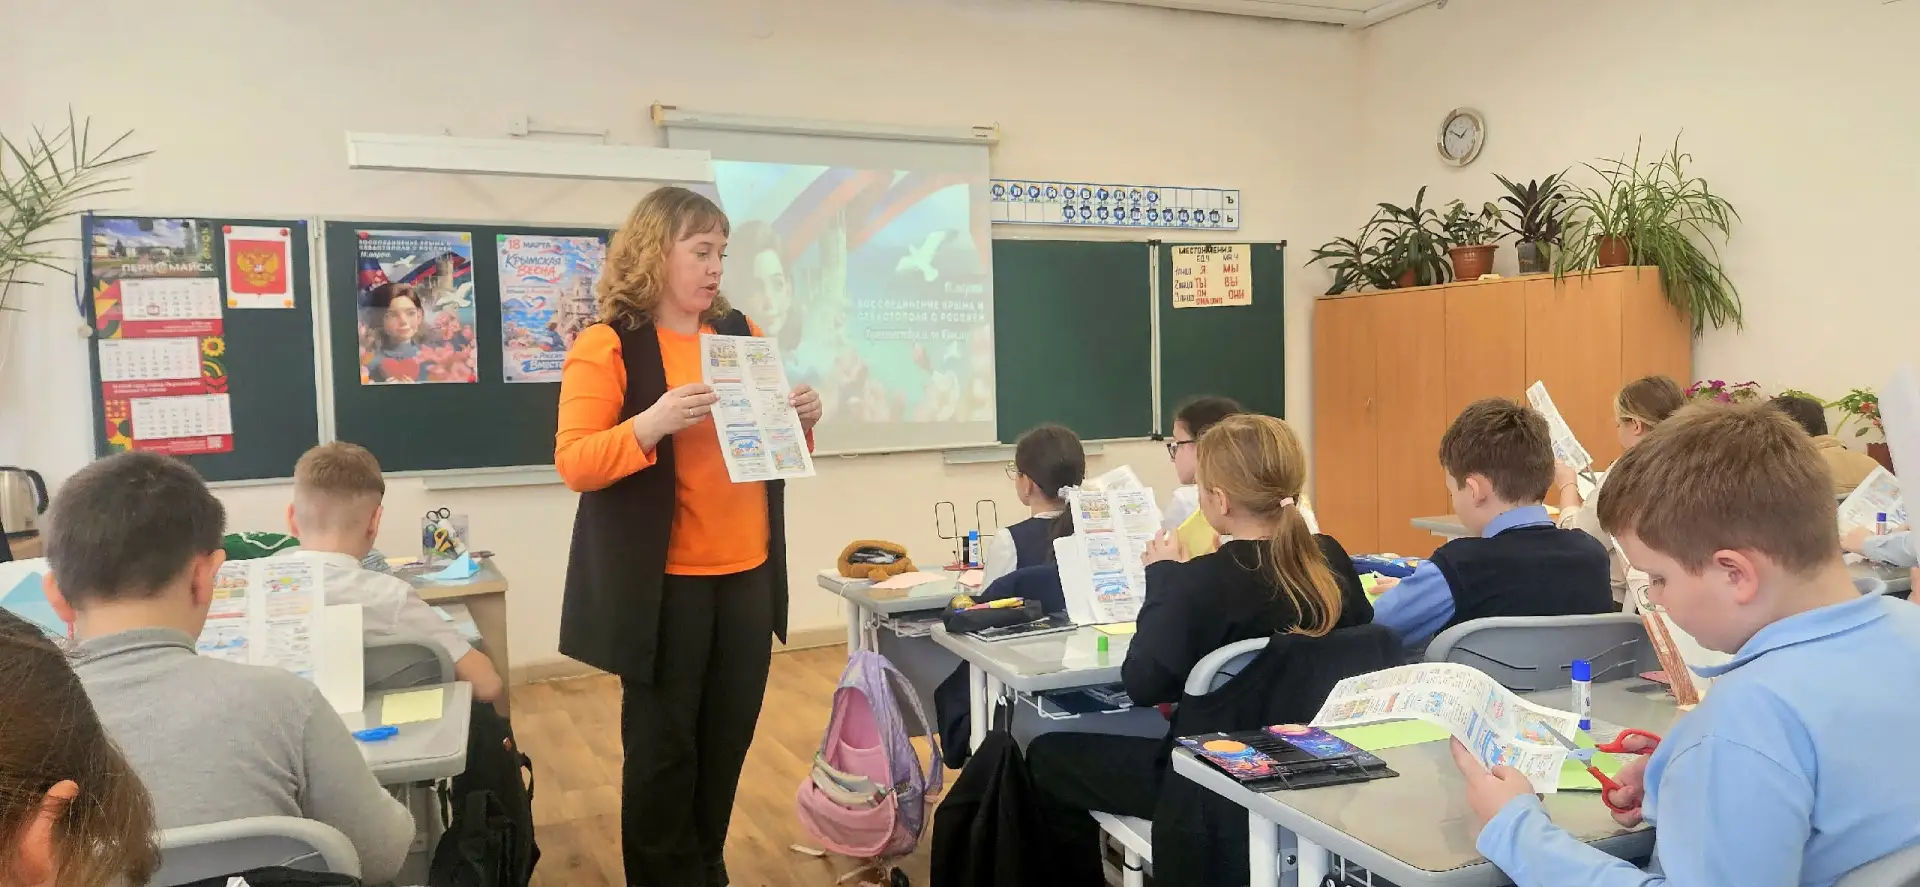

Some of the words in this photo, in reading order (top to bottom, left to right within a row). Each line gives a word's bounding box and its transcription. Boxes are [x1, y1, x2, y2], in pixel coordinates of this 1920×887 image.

[1226, 196, 1234, 204] Ъ
[1227, 215, 1234, 223] Ь
[508, 239, 520, 250] 18
[1200, 264, 1206, 275] Я
[1223, 264, 1239, 274] МЫ
[1224, 276, 1238, 287] ВЫ
